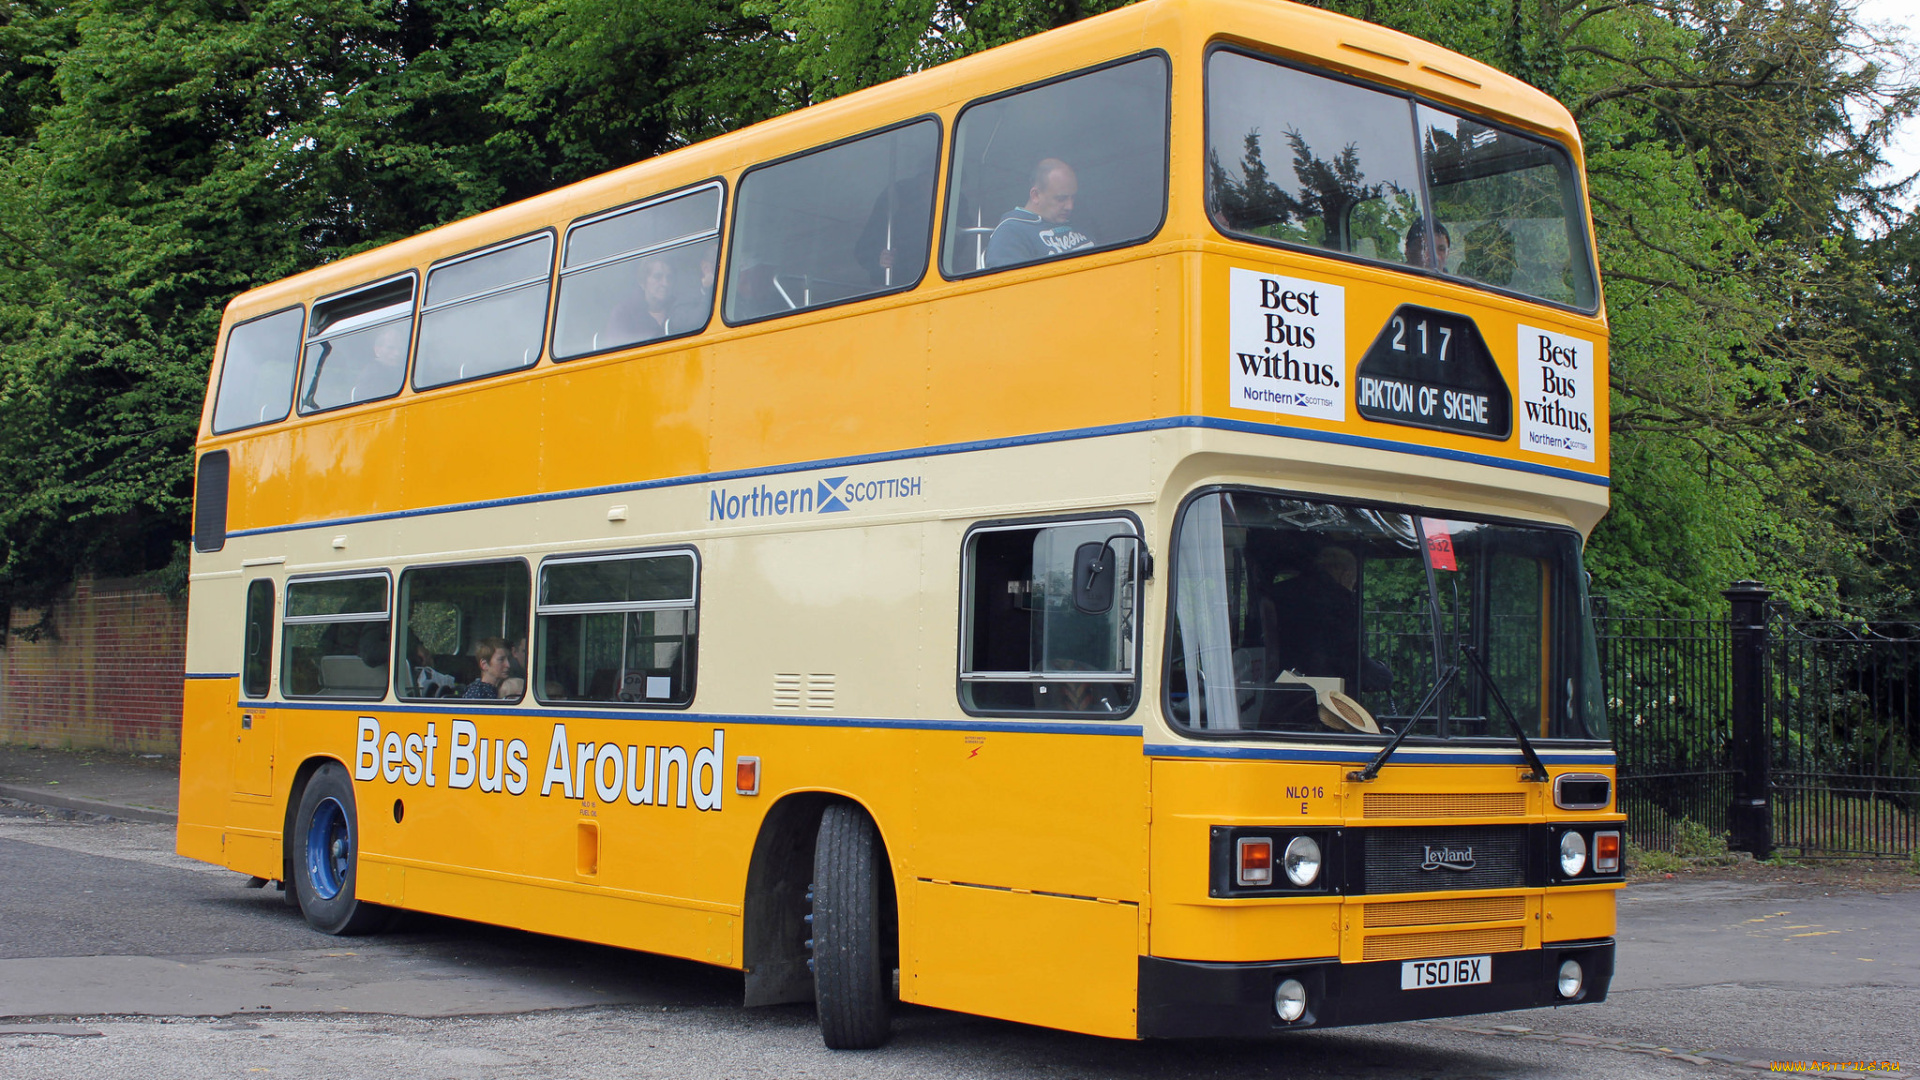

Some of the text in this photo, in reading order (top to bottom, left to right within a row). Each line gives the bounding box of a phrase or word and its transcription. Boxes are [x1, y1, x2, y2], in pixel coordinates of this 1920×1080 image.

[1259, 278, 1319, 317] Best
[1263, 313, 1316, 349] Bus
[1391, 315, 1452, 361] 217
[1538, 334, 1578, 370] Best
[1243, 386, 1333, 407] Northern SCOTTISH
[1541, 366, 1576, 399] Bus
[1418, 385, 1439, 416] OF
[1443, 389, 1489, 425] SKENE
[1529, 431, 1563, 448] Northern
[709, 476, 922, 521] Northern SCOTTISH
[354, 716, 725, 812] Best Bus Around
[1286, 786, 1324, 799] NLO 16
[1301, 802, 1308, 814] E
[1421, 845, 1477, 870] Leyland
[1413, 959, 1481, 986] TSO 16X
